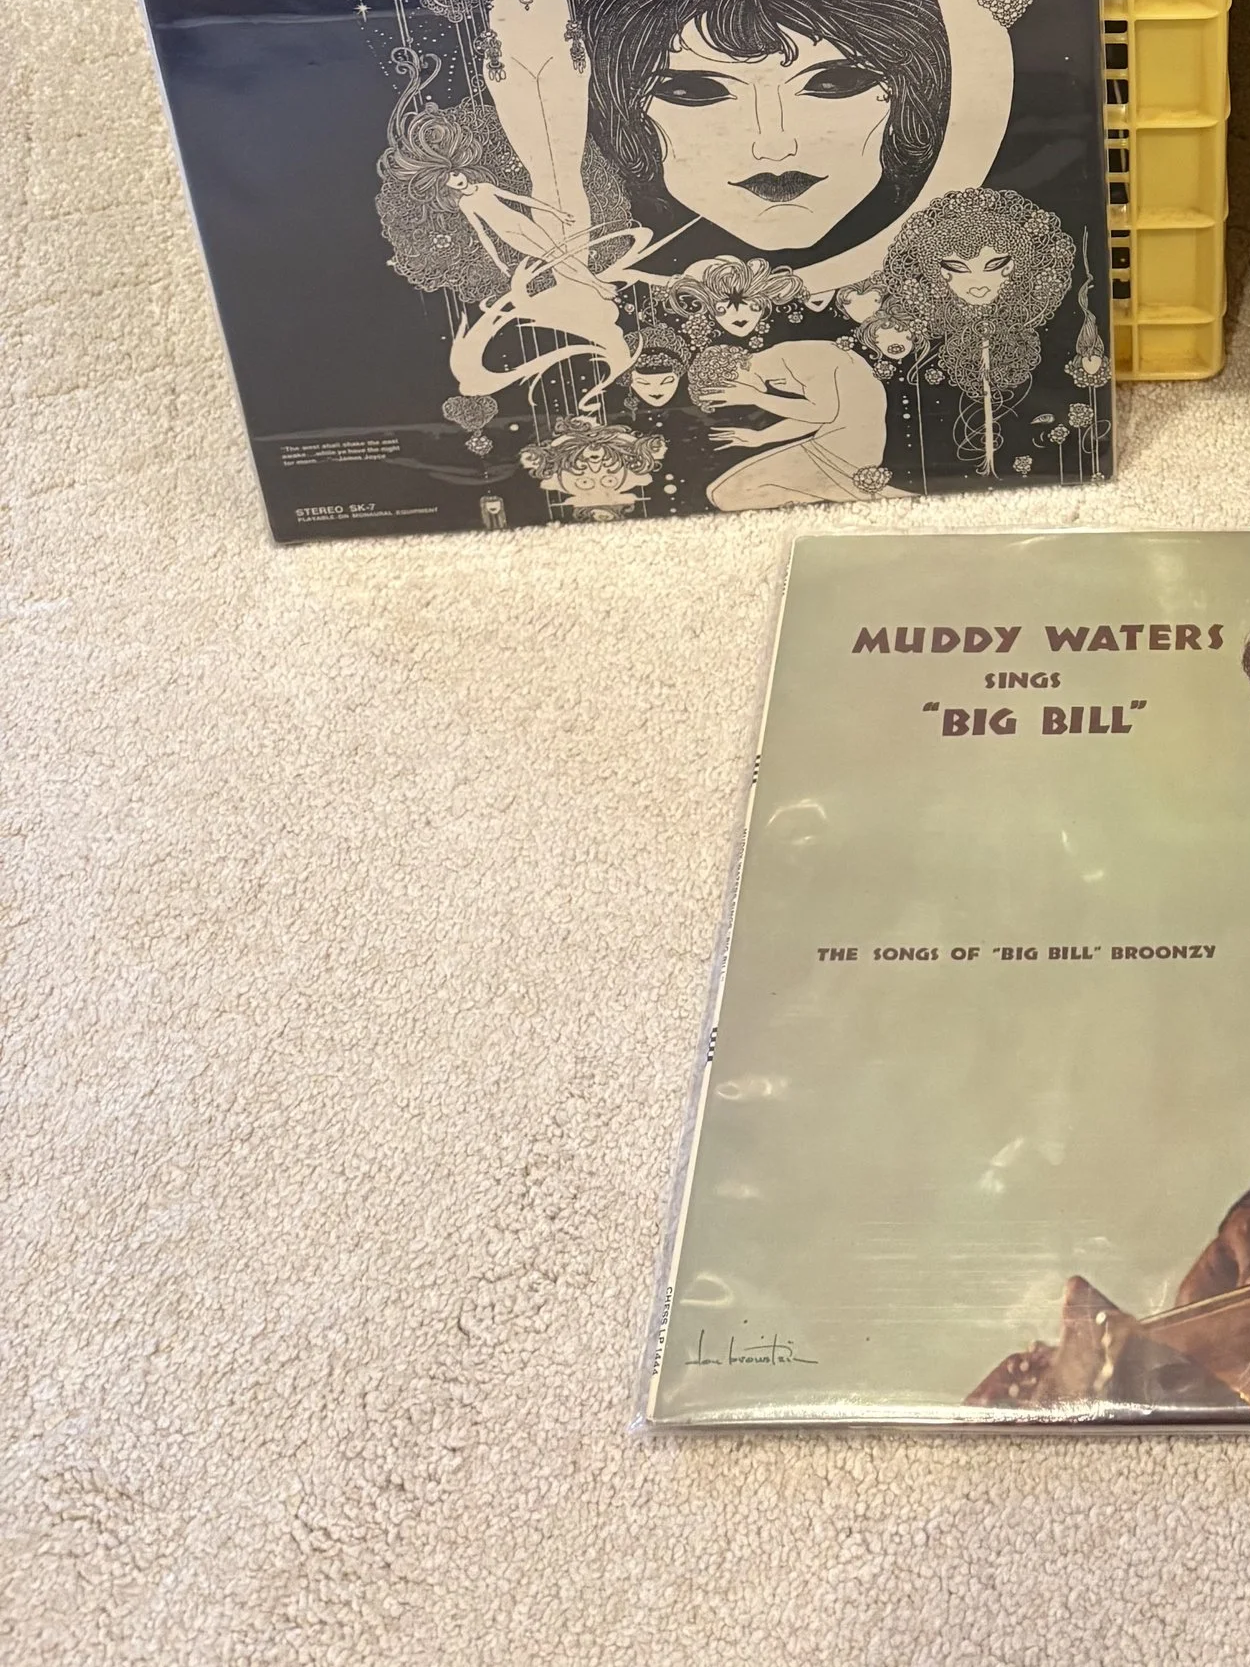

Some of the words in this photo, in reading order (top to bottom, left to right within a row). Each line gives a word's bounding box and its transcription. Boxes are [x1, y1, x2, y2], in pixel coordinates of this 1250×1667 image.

[342, 441, 366, 449] shake
[381, 444, 400, 453] night
[295, 504, 344, 517] STEREO
[349, 503, 376, 513] SK-7
[352, 510, 393, 518] MONAURAL
[396, 506, 438, 516] EQUIPMENT
[851, 626, 1022, 655] MUDDY
[1047, 623, 1226, 652] WATERS
[984, 671, 1062, 690] SINGS
[922, 701, 1017, 736] "BIG
[1042, 699, 1148, 735] BILL"
[817, 947, 858, 961] THE
[872, 946, 940, 961] SONGS
[949, 946, 981, 960] OF
[992, 946, 1039, 960] "BIG
[1047, 946, 1103, 960] BILL"
[1110, 944, 1218, 960] BROONZY
[660, 1286, 672, 1325] CHESS
[657, 1328, 665, 1343] LP
[652, 1347, 662, 1374] 1444
